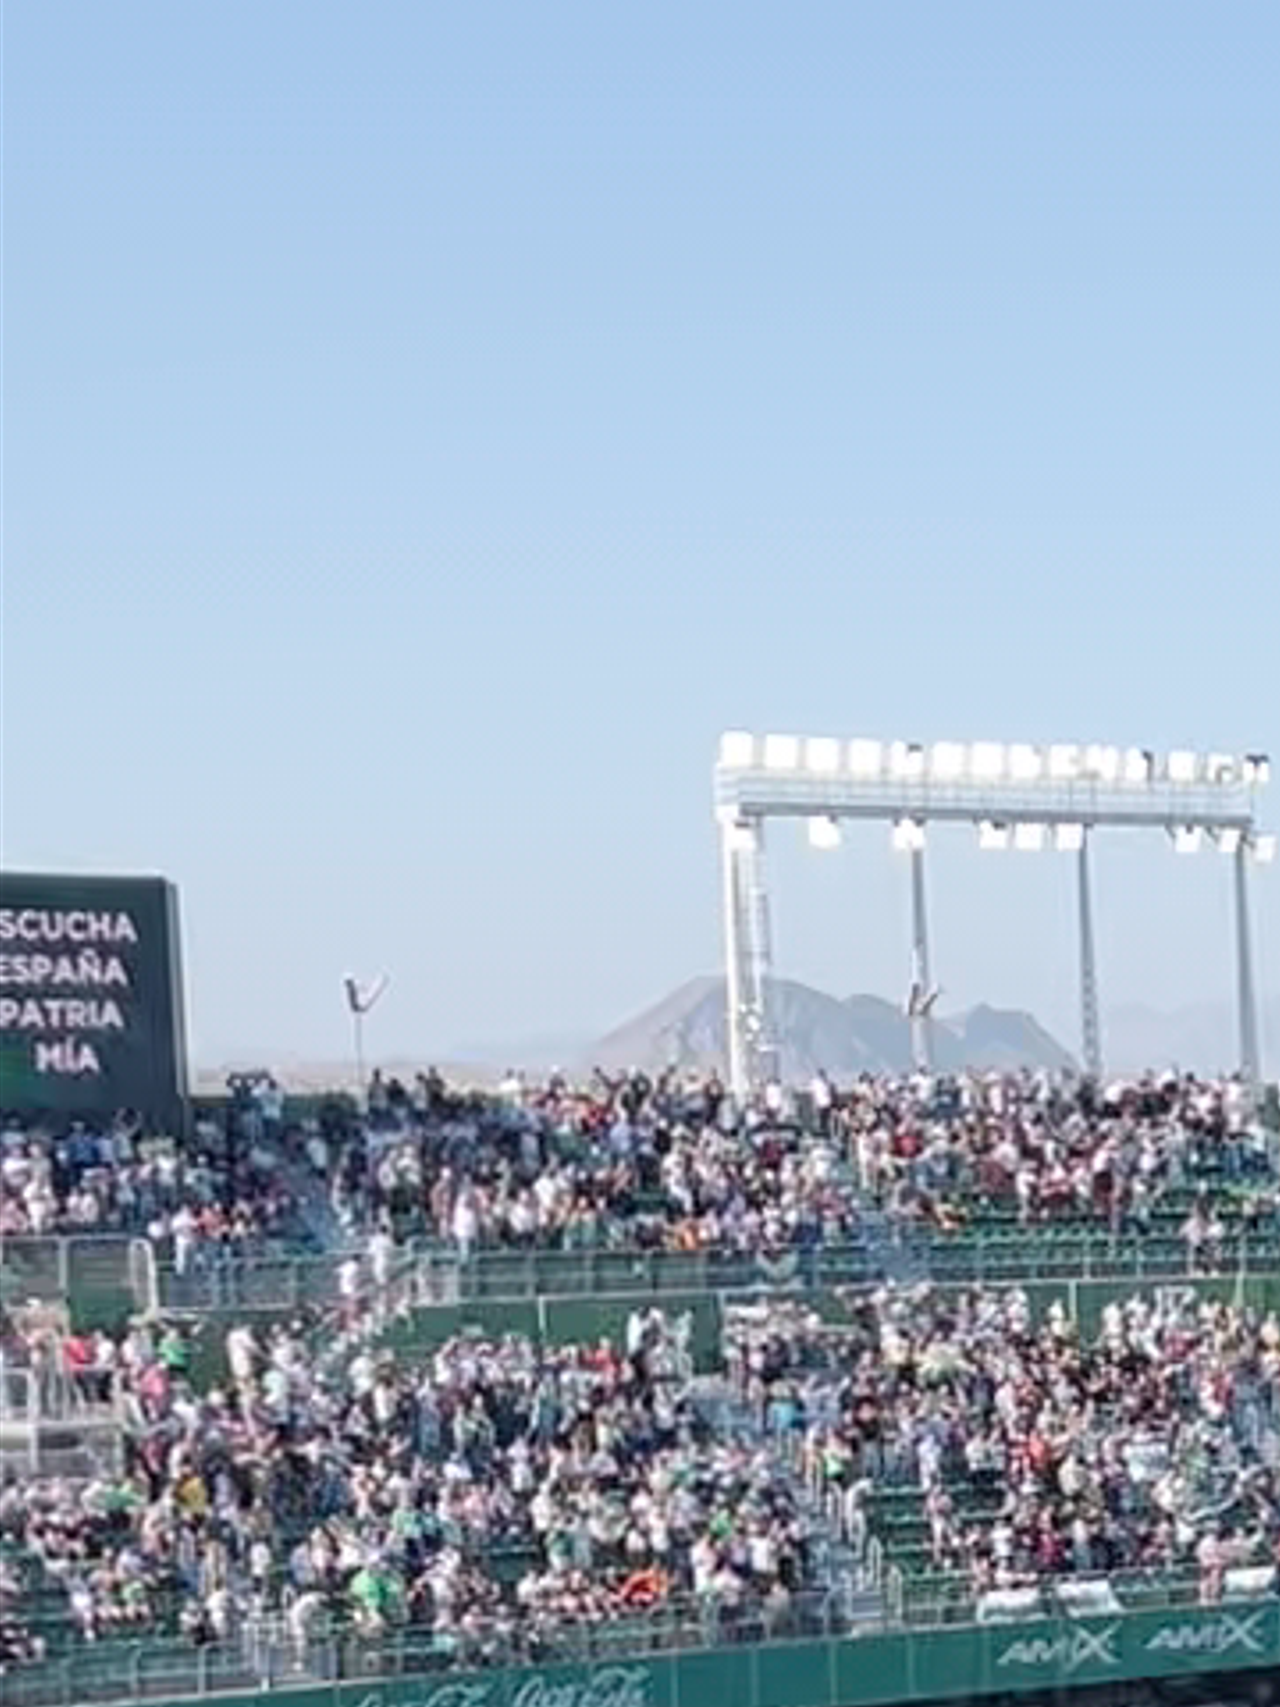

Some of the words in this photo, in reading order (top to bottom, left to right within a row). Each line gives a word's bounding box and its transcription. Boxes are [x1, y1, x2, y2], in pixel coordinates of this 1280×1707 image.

[0, 909, 138, 942] SCUCHA
[0, 949, 128, 986] ESPAÑA
[0, 998, 124, 1029] PATRIA
[35, 1039, 101, 1073] MÍA
